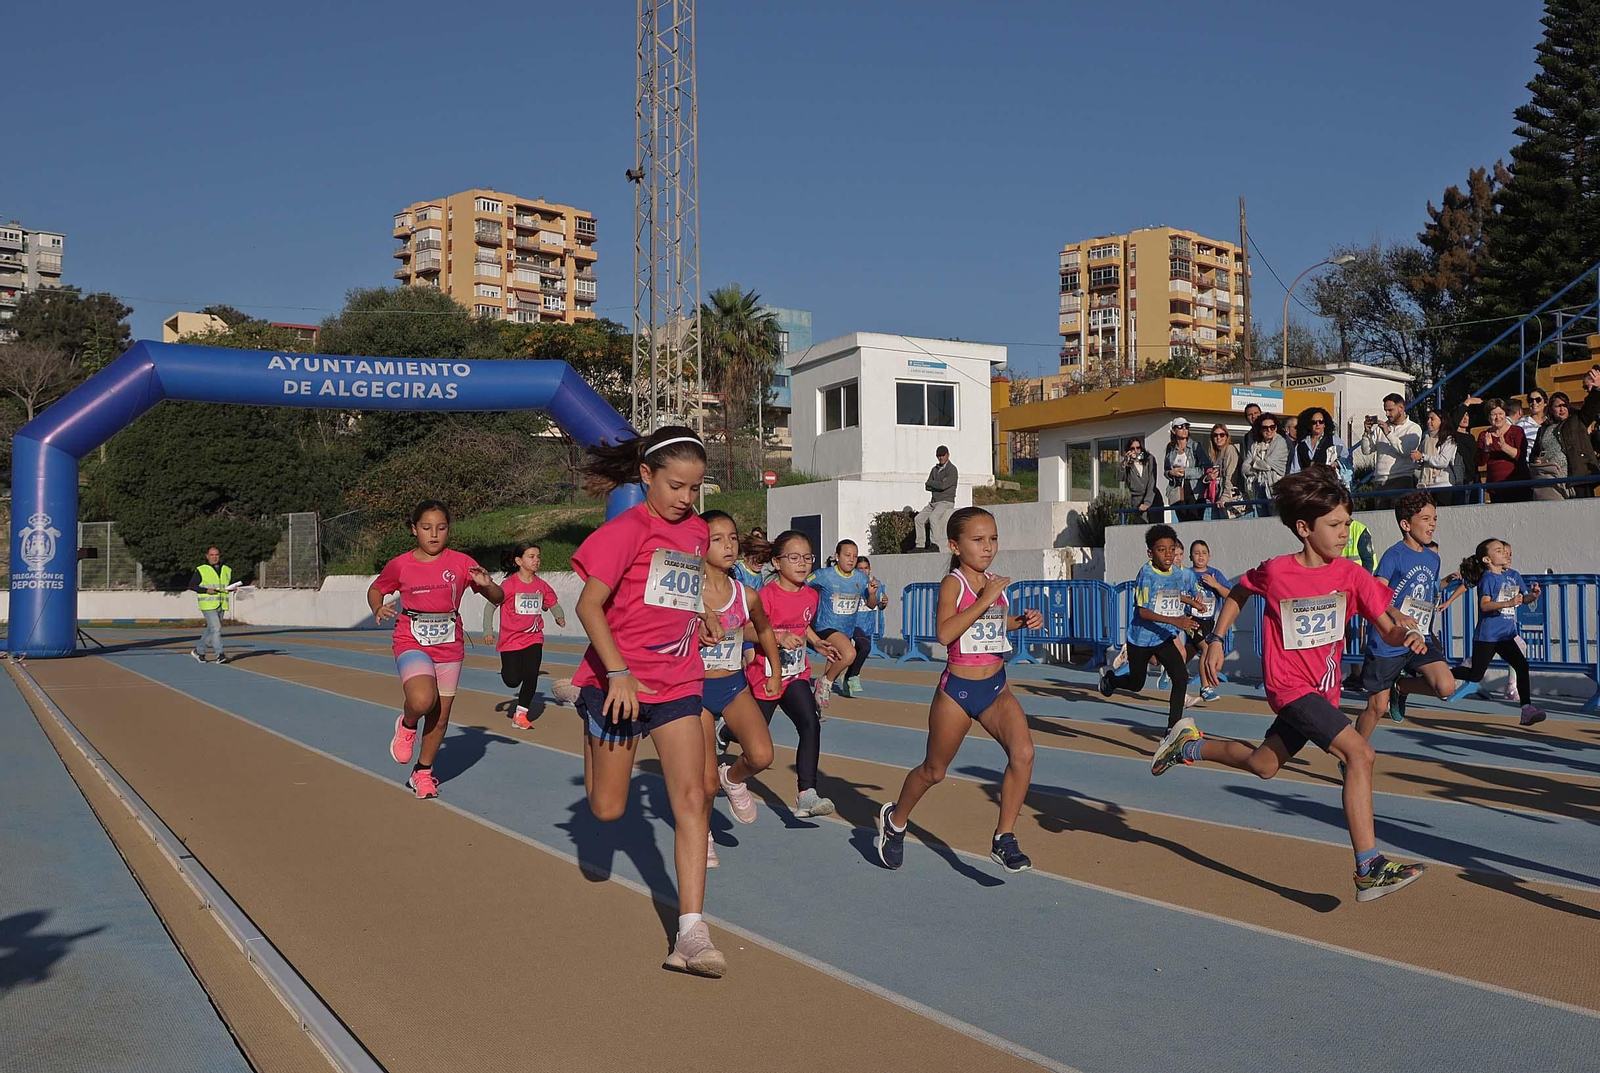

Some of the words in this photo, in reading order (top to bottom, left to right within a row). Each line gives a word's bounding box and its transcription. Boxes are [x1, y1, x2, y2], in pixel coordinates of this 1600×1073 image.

[267, 355, 471, 377] AYUNTAMIENTO
[283, 380, 312, 394] DE
[318, 379, 458, 399] ALGECIRAS
[12, 572, 54, 580] DELEGACIÓN
[660, 569, 700, 596] 408
[11, 580, 64, 590] DEPORTES
[519, 600, 539, 609] 460
[837, 600, 856, 609] 412
[1161, 598, 1180, 610] 310
[1316, 602, 1337, 610] ALGECIRAS
[1295, 610, 1337, 635] 321
[1407, 608, 1430, 626] 316
[418, 623, 449, 637] 353
[971, 621, 1004, 641] 334
[699, 643, 736, 660] 447
